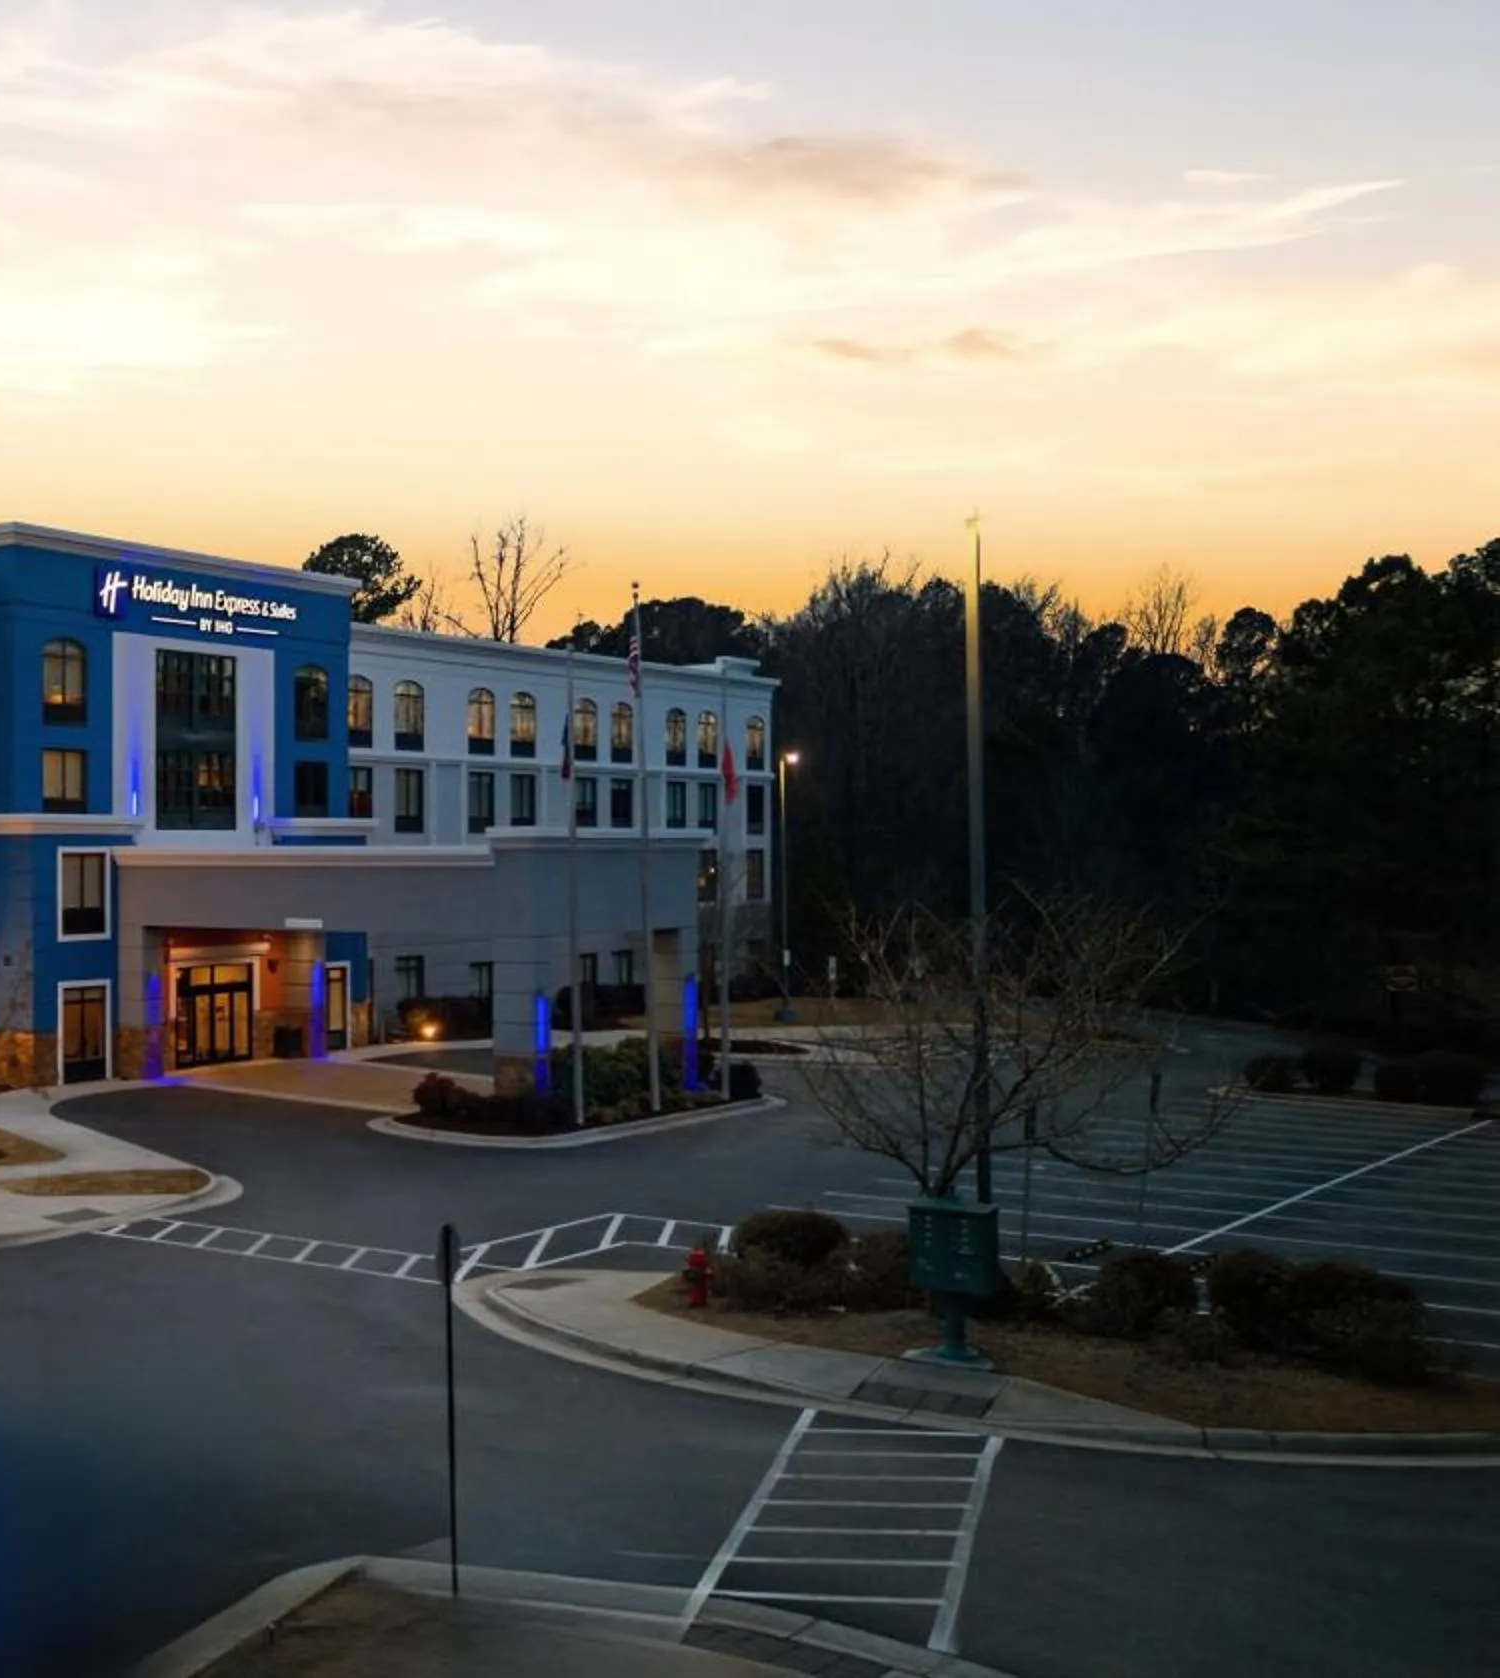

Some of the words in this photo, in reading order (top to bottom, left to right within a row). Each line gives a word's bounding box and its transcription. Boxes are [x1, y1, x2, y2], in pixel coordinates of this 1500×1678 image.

[132, 575, 189, 611] Holiday
[191, 584, 213, 609] Inn
[215, 590, 260, 616] Express
[262, 602, 268, 617] &
[269, 602, 297, 620] Suites
[199, 618, 213, 632] BY
[214, 620, 233, 634] IHG
